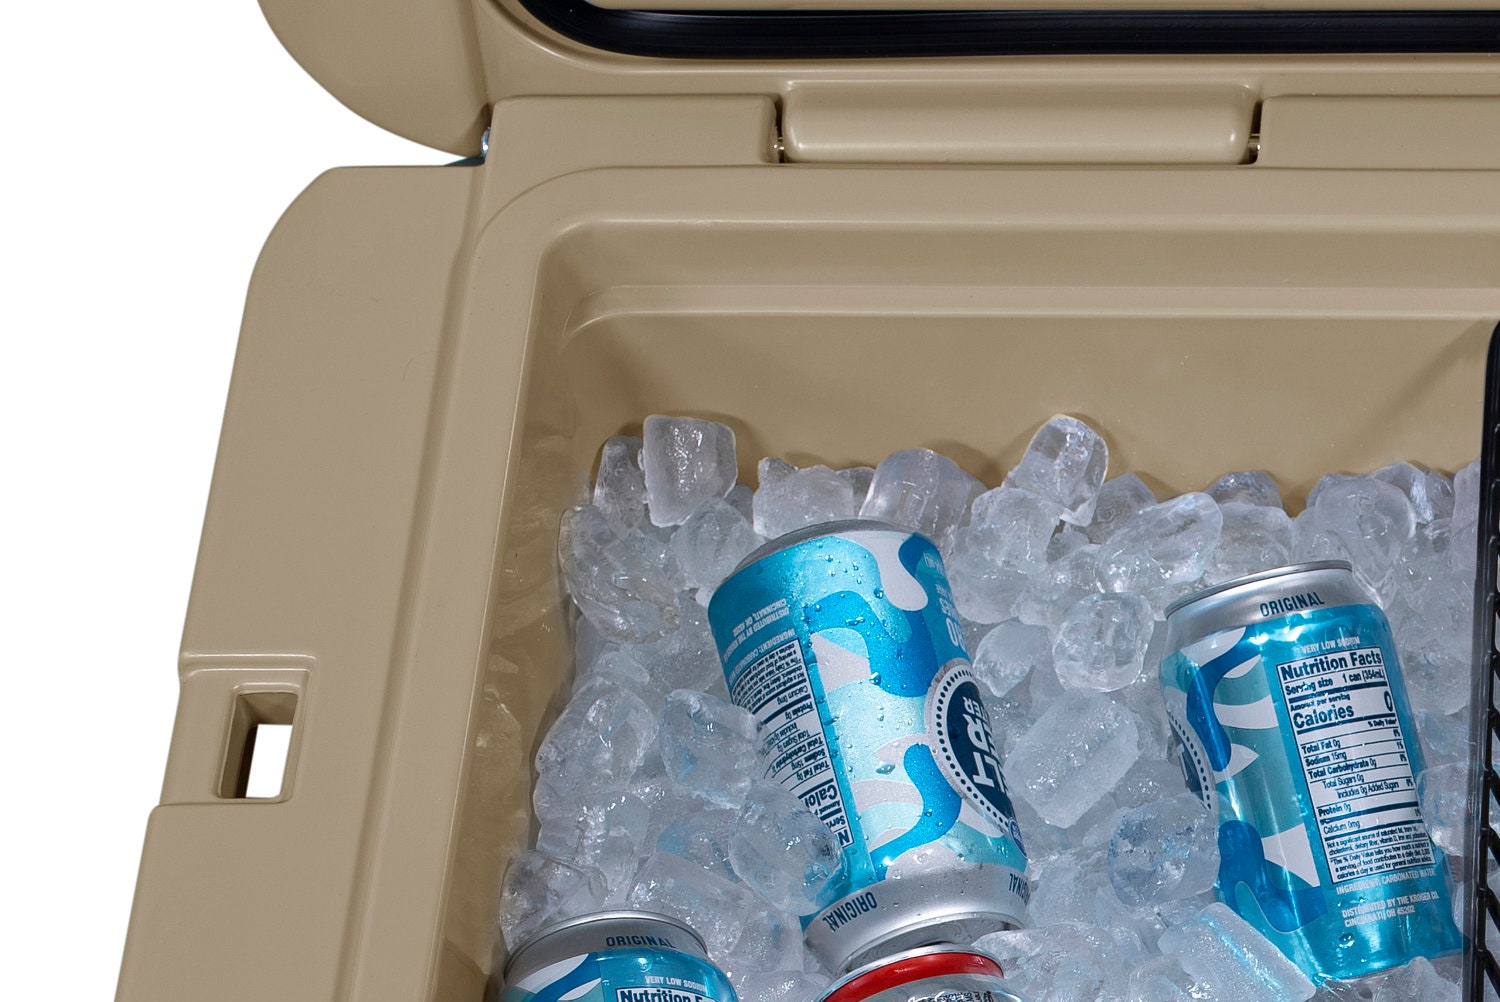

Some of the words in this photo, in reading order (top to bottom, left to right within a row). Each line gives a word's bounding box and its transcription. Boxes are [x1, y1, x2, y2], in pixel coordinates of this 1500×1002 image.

[1260, 592, 1325, 617] ORIGINAL
[1280, 656, 1348, 681] Nutrition
[1350, 651, 1382, 670] Facts
[1285, 682, 1316, 696] Serving
[1318, 677, 1333, 688] size
[1349, 673, 1362, 682] can
[1293, 704, 1354, 729] Calories
[1384, 691, 1393, 712] 0
[1302, 742, 1320, 754] Total
[1321, 740, 1332, 749] Fat
[814, 761, 829, 773] Total
[1305, 754, 1330, 767] Sodium
[1331, 751, 1348, 761] 15mg
[1308, 768, 1326, 779] Total
[1327, 760, 1369, 775] Carbohydrate
[1323, 778, 1337, 789] Total
[1338, 775, 1356, 786] Sugars
[1337, 787, 1360, 799] Includes
[1368, 783, 1384, 793] Added
[1384, 781, 1399, 791] Sugars
[1318, 805, 1342, 817] Protein
[1324, 822, 1347, 834] Calcium
[822, 892, 878, 932] ORIGINAL
[606, 936, 676, 948] ORIGINAL
[645, 976, 664, 984] VERY
[666, 977, 682, 986] LOW
